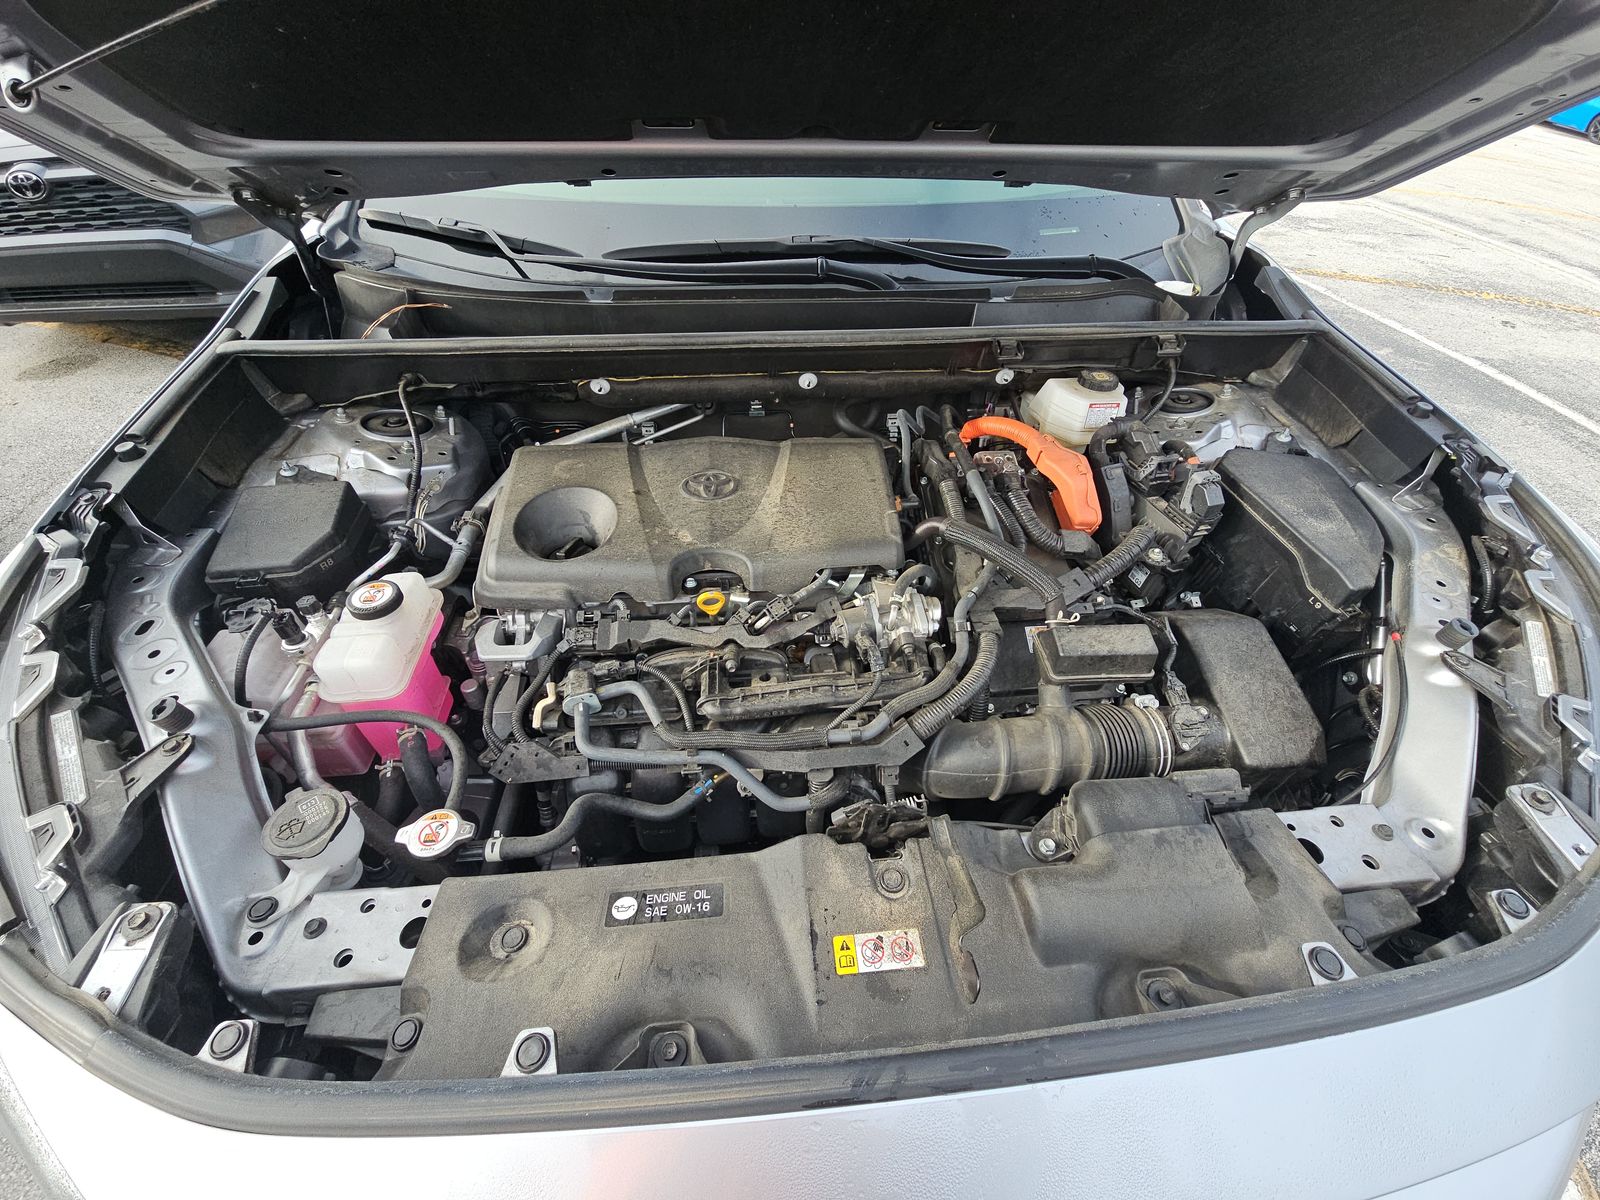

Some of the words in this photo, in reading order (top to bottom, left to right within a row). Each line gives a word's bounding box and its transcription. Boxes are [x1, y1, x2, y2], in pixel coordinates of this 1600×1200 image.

[319, 558, 334, 570] R8
[1308, 596, 1322, 609] L9
[646, 891, 687, 904] ENGINE
[693, 889, 711, 900] OIL
[644, 905, 668, 917] SAE
[675, 902, 710, 914] 0W-16
